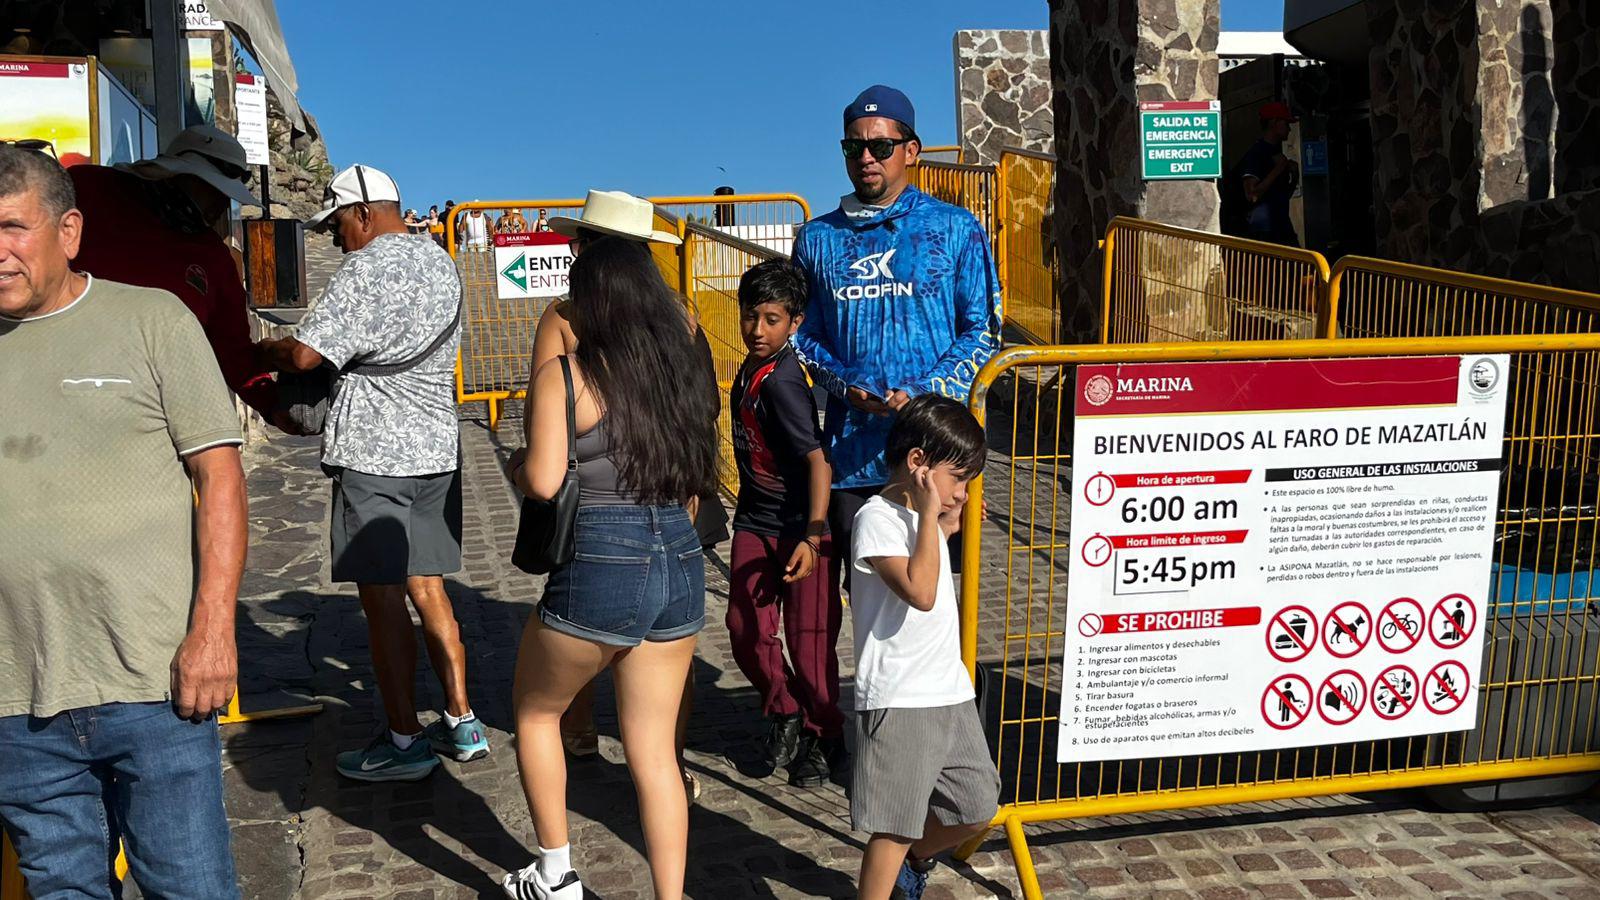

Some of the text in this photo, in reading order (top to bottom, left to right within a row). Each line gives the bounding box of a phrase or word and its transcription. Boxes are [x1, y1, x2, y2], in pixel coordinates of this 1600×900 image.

[1153, 117, 1208, 127] SALIDA DE
[1146, 130, 1216, 141] EMERGENCIA
[1149, 148, 1215, 159] EMERGENCY
[1171, 163, 1194, 173] EXIT
[530, 256, 573, 270] ENTR
[531, 274, 569, 288] ENTR
[834, 282, 913, 301] KOOFIN
[1117, 377, 1194, 393] MARINA
[1094, 417, 1487, 455] BIENVENIDOS AL FARO DE MAZATLÁN
[1293, 460, 1478, 480] USO GENERAL DE LAS INSTALACIONES
[1137, 475, 1215, 485] Hora de apertura
[1289, 488, 1315, 497] espacio
[1327, 486, 1345, 494] 100%
[1122, 495, 1237, 523] 6:00 am
[1296, 504, 1328, 513] personas
[1372, 499, 1415, 508] sorprendidas
[1455, 495, 1488, 503] conductas
[1271, 514, 1318, 523] inapropiadas,
[1320, 511, 1364, 520] ocasionando
[1365, 510, 1385, 518] daños
[1405, 507, 1447, 515] instalaciones
[1449, 506, 1460, 514] y/o
[1297, 524, 1303, 532] la
[1305, 523, 1325, 531] moral
[1332, 522, 1357, 530] buenas
[1358, 519, 1399, 528] costumbres,
[1127, 538, 1148, 547] Hora
[1179, 535, 1191, 544] de
[1193, 535, 1227, 545] ingreso
[1292, 534, 1323, 542] turnadas
[1345, 530, 1385, 539] autoridades
[1388, 527, 1447, 537] correspondientes,
[1290, 545, 1309, 553] daño,
[1311, 543, 1340, 551] deberán
[1341, 541, 1361, 549] cubrir
[1374, 540, 1395, 548] gastos
[1280, 562, 1312, 571] ASIPONA
[1397, 555, 1436, 564] responsable
[1440, 554, 1451, 562] por
[1267, 574, 1297, 583] perdidas
[1326, 570, 1350, 578] dentro
[1357, 568, 1374, 576] fuera
[1396, 565, 1439, 573] instalaciones
[1118, 610, 1224, 632] SE PROHIBE
[1079, 646, 1085, 654] 1.
[1090, 645, 1122, 654] Ingresar
[1124, 643, 1164, 651] alimentos
[1173, 639, 1220, 649] desechables
[1078, 658, 1085, 666] 2.
[1089, 657, 1121, 666] Ingresar
[1140, 654, 1177, 662] mascotas
[1077, 670, 1084, 678] 3.
[1088, 669, 1120, 678] Ingresar
[1140, 666, 1176, 674] bicicletas
[1087, 679, 1139, 688] Ambulantaje
[1141, 677, 1155, 687] y/o
[1157, 676, 1193, 685] comercio
[1195, 673, 1229, 682] informal
[1107, 691, 1134, 700] basura
[1074, 705, 1081, 713] 6.
[1086, 703, 1123, 712] Encender
[1126, 702, 1154, 711] fogatas
[1164, 700, 1198, 708] braseros
[1116, 714, 1147, 722] bebidas
[1197, 709, 1221, 717] armas
[1223, 707, 1236, 717] y/o
[1083, 736, 1099, 745] Uso
[1101, 736, 1111, 744] de
[1113, 735, 1149, 745] aparatos
[1151, 734, 1165, 743] que
[1168, 732, 1195, 740] emitan
[1197, 730, 1216, 738] altos
[1218, 727, 1254, 736] decibeles
